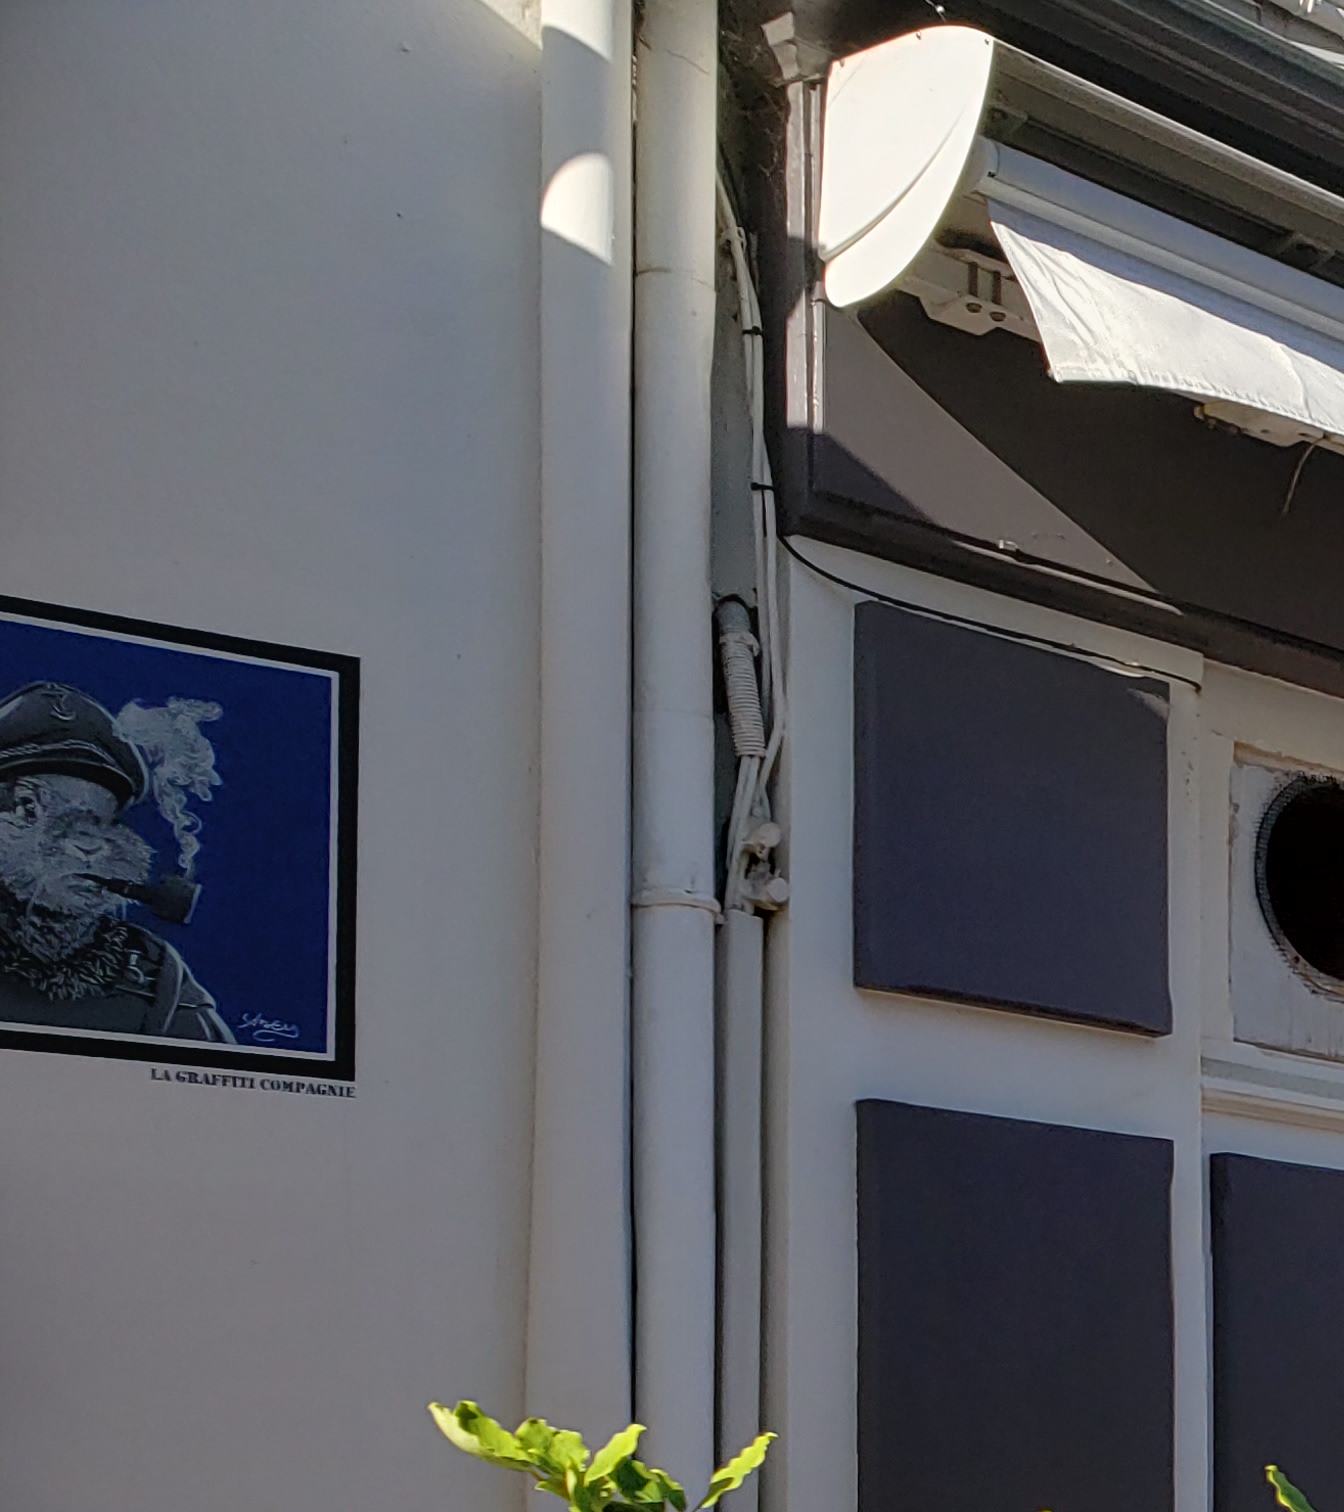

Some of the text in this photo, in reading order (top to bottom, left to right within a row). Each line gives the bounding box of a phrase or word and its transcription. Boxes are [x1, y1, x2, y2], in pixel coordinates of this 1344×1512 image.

[151, 1068, 356, 1099] LA GRAFFITI COMPAGNIE
